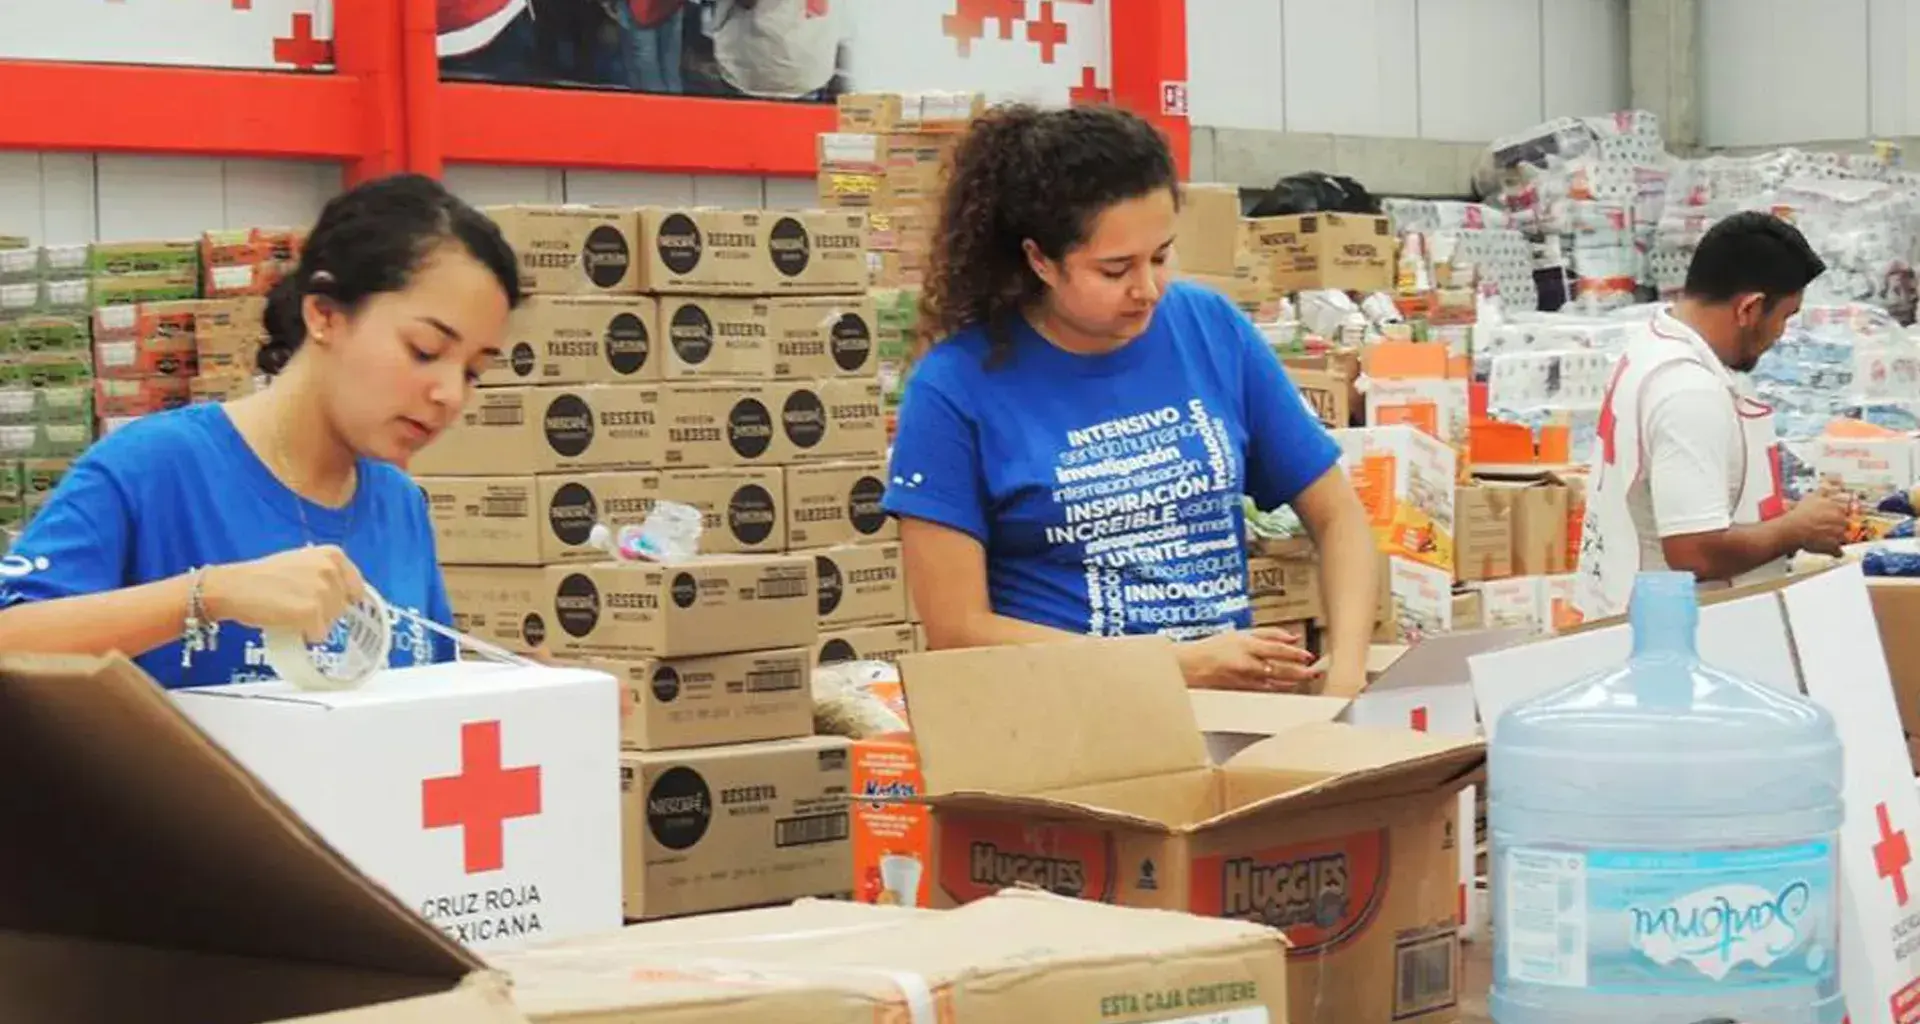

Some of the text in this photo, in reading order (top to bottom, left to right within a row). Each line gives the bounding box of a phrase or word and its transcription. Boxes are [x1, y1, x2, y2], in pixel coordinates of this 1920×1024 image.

[708, 232, 756, 247] RESERVA
[815, 235, 861, 249] RESERVA
[718, 322, 765, 337] RESERVA
[548, 341, 598, 357] RESERVA
[601, 411, 656, 426] RESERVA
[1067, 406, 1180, 447] INTENSIVO
[668, 428, 721, 442] RESERVA
[1065, 474, 1210, 523] INSPIRACIÓN
[1045, 503, 1178, 544] INCREIBLE
[848, 567, 897, 584] RESERVA
[721, 785, 777, 804] RESERVA
[970, 841, 1085, 890] HUGGIES
[1222, 852, 1348, 917] HUGGIES
[421, 884, 542, 921] CRUZ ROJA
[1100, 981, 1258, 1018] ESTA CAJA CONTIENE
